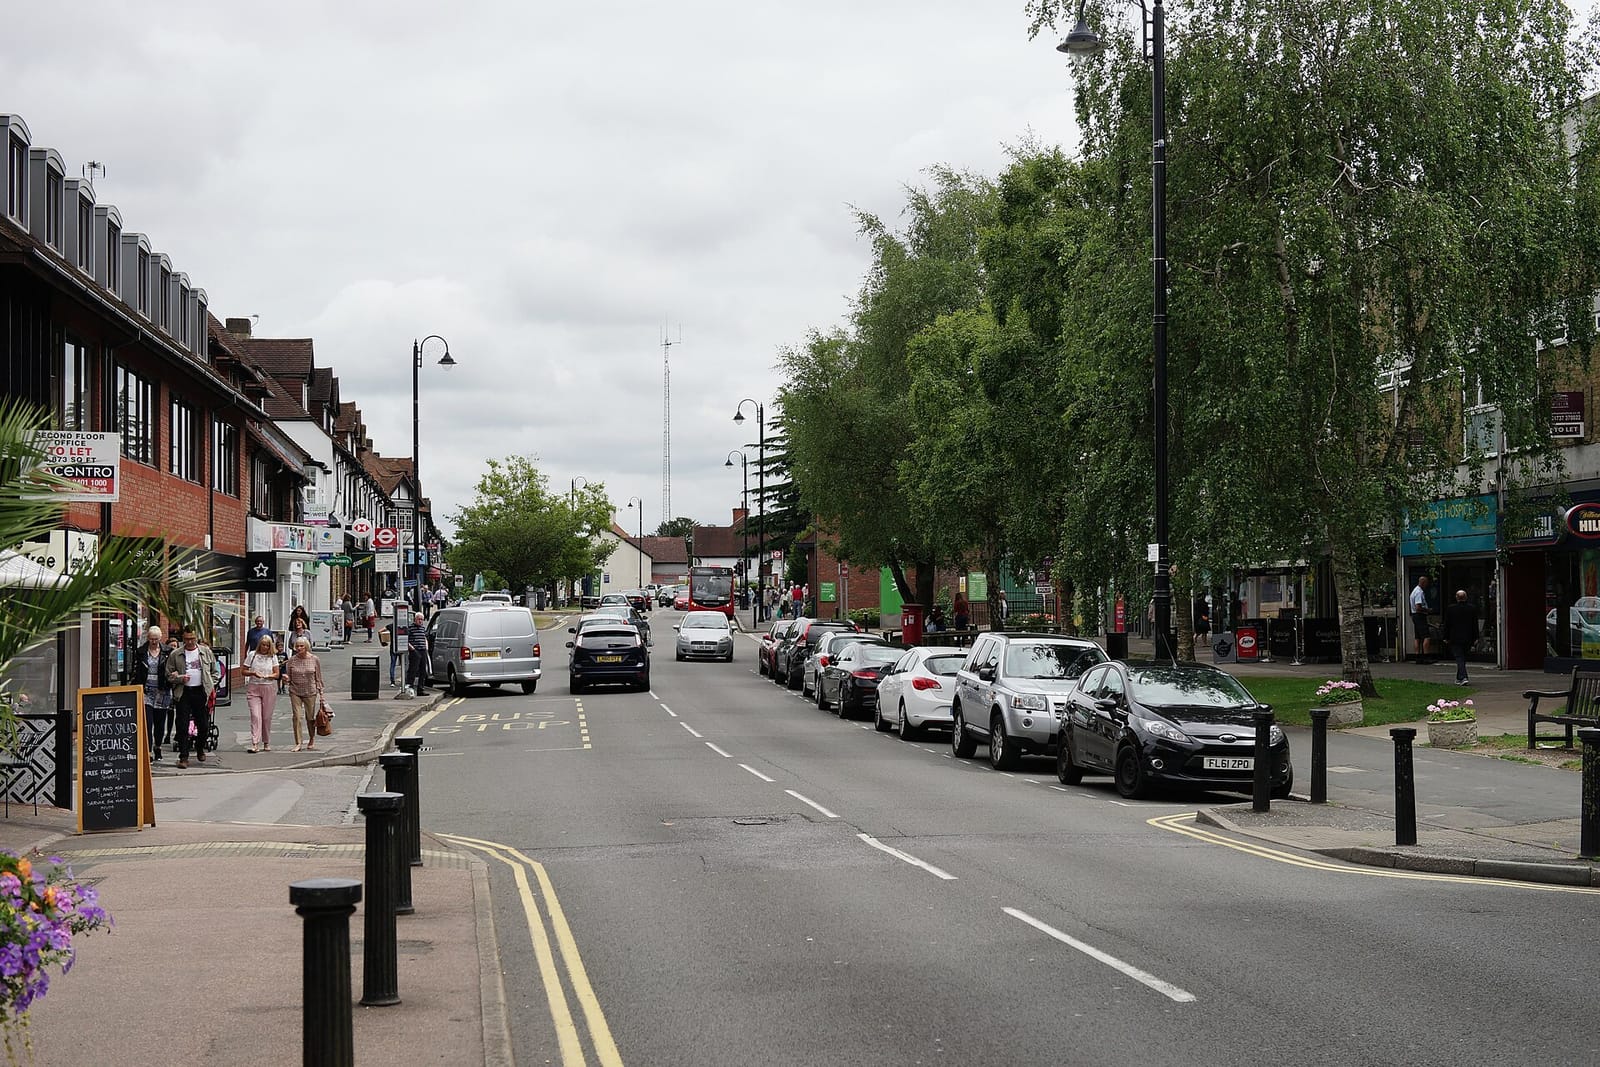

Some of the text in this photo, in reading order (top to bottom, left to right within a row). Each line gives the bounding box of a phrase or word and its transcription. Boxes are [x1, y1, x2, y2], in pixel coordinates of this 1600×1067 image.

[48, 446, 92, 456] TO LET
[91, 479, 107, 487] 1000
[86, 707, 133, 721] CHECK OUT
[456, 711, 555, 722] BUS
[114, 722, 138, 735] SALAD
[428, 720, 570, 734] STOP
[88, 737, 130, 753] SPECIALS
[1208, 759, 1229, 769] FL61
